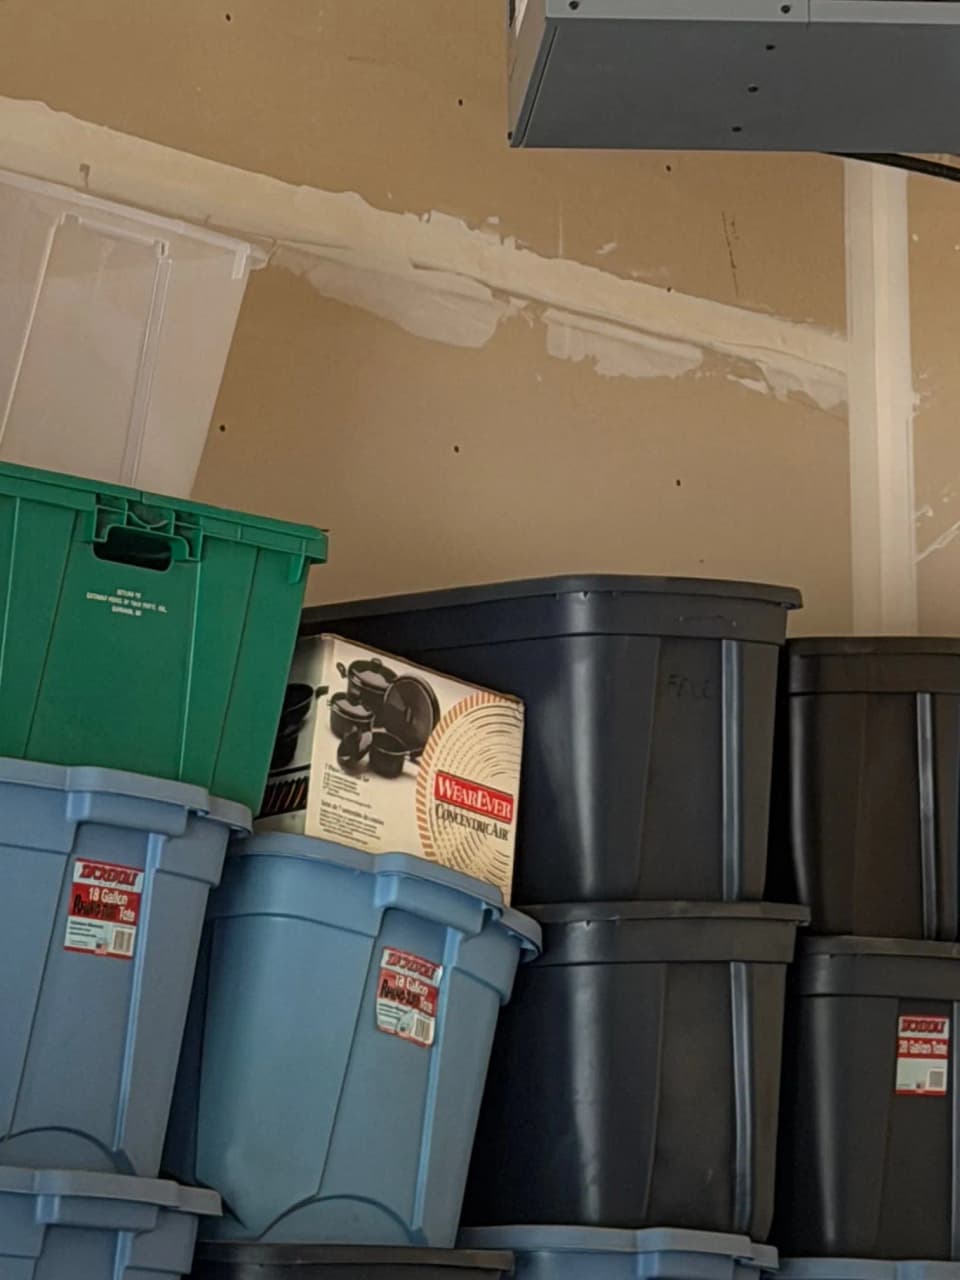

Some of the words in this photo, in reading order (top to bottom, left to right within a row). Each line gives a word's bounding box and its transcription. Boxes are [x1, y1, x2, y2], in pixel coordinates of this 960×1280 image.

[89, 887, 100, 902] 18
[101, 888, 128, 905] Gallon
[119, 906, 135, 922] Tote
[395, 975, 405, 989] 18
